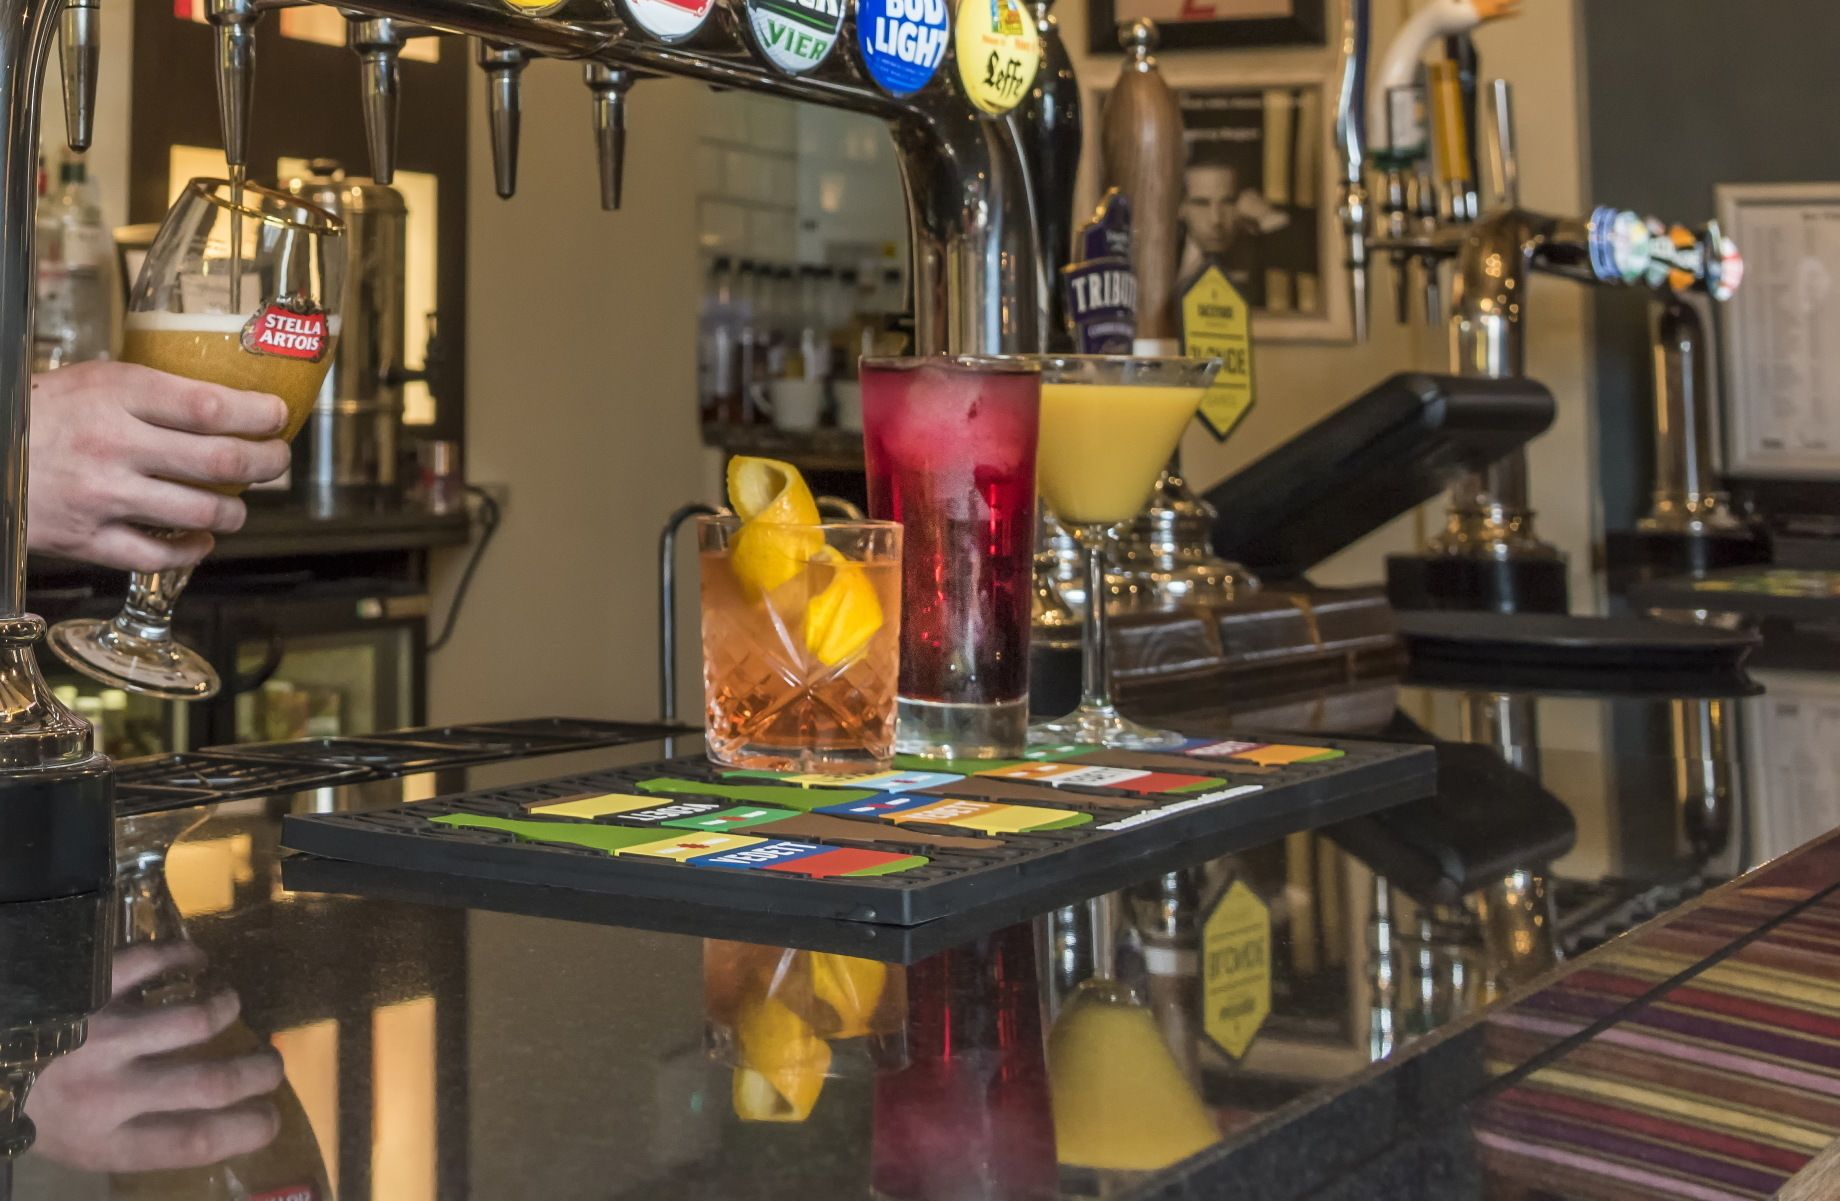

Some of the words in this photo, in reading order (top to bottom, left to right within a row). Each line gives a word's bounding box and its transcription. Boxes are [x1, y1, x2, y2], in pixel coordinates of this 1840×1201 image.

[768, 19, 828, 61] VIER
[875, 16, 949, 69] LIGHT
[982, 50, 1024, 99] Leffe
[1072, 270, 1138, 314] TRIBUT
[259, 329, 320, 350] ARTOIS
[265, 313, 321, 335] STELLA
[617, 803, 719, 821] VEDETT
[708, 841, 817, 864] VEDETT
